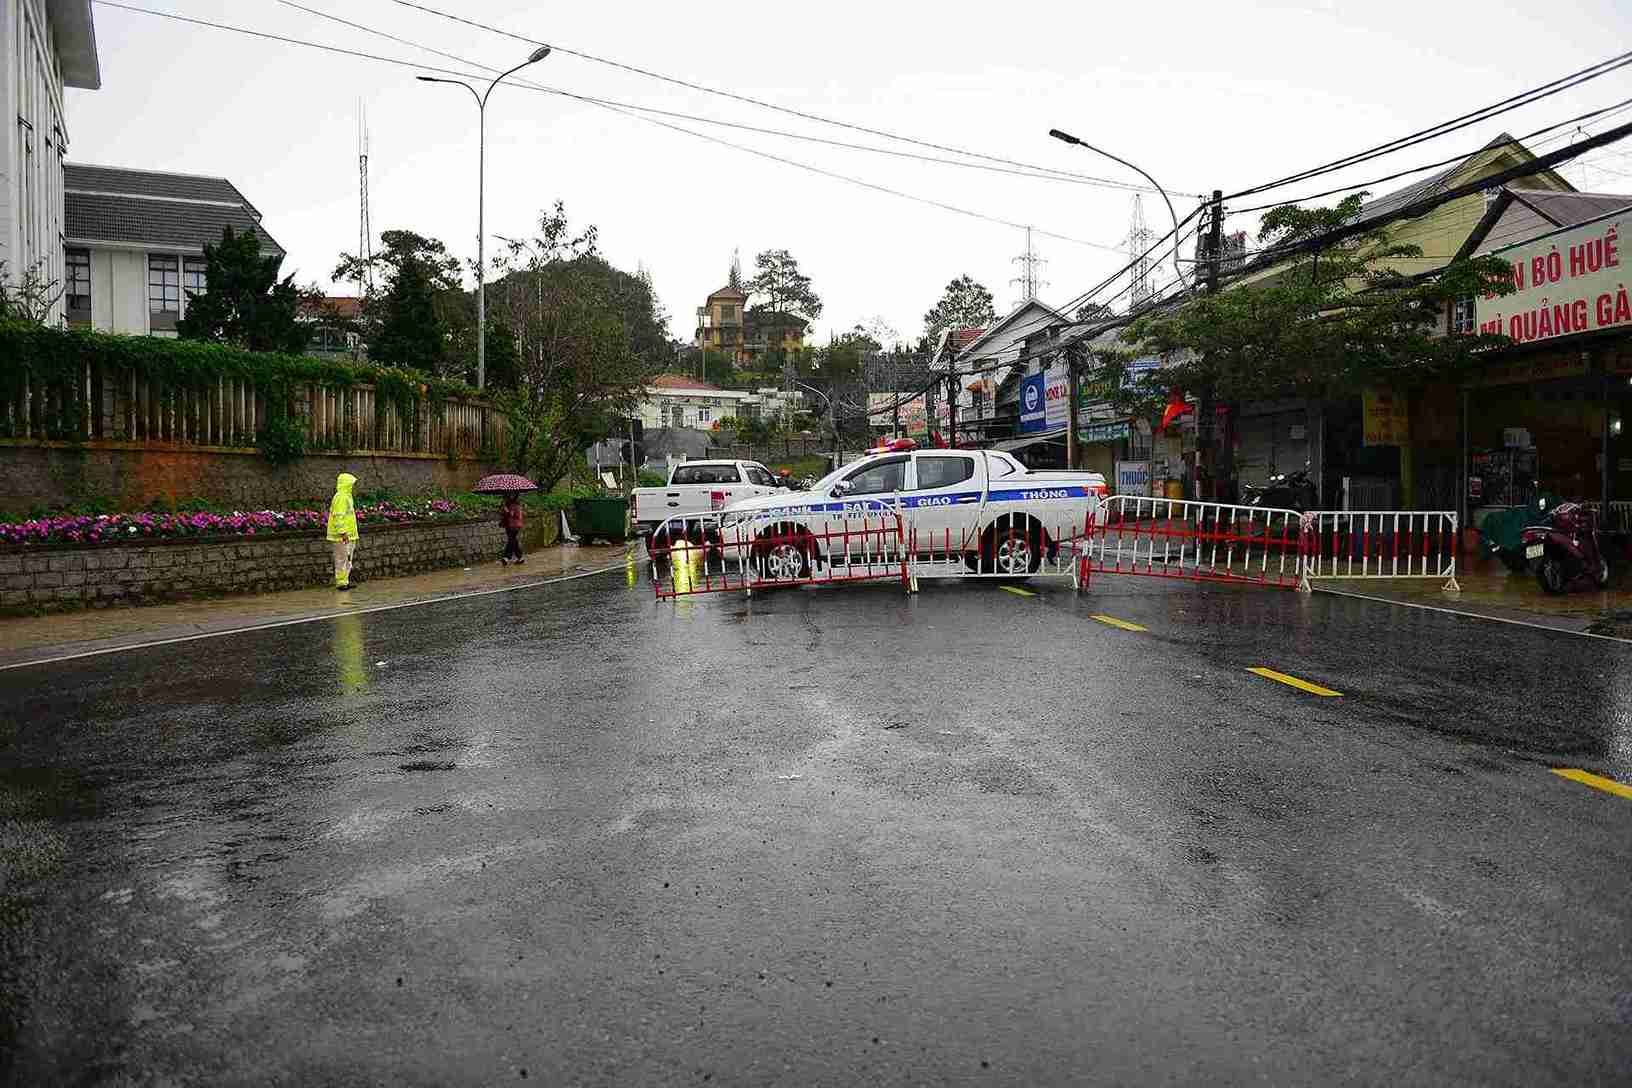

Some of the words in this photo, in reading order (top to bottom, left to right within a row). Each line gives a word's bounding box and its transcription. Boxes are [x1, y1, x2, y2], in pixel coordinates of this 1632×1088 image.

[1532, 245, 1562, 287] BÒ
[1570, 223, 1619, 277] HUẾ
[1510, 298, 1588, 343] QUẢNG
[1596, 283, 1632, 326] GÀ
[917, 496, 951, 507] GIAO
[1020, 488, 1068, 499] THÔNG
